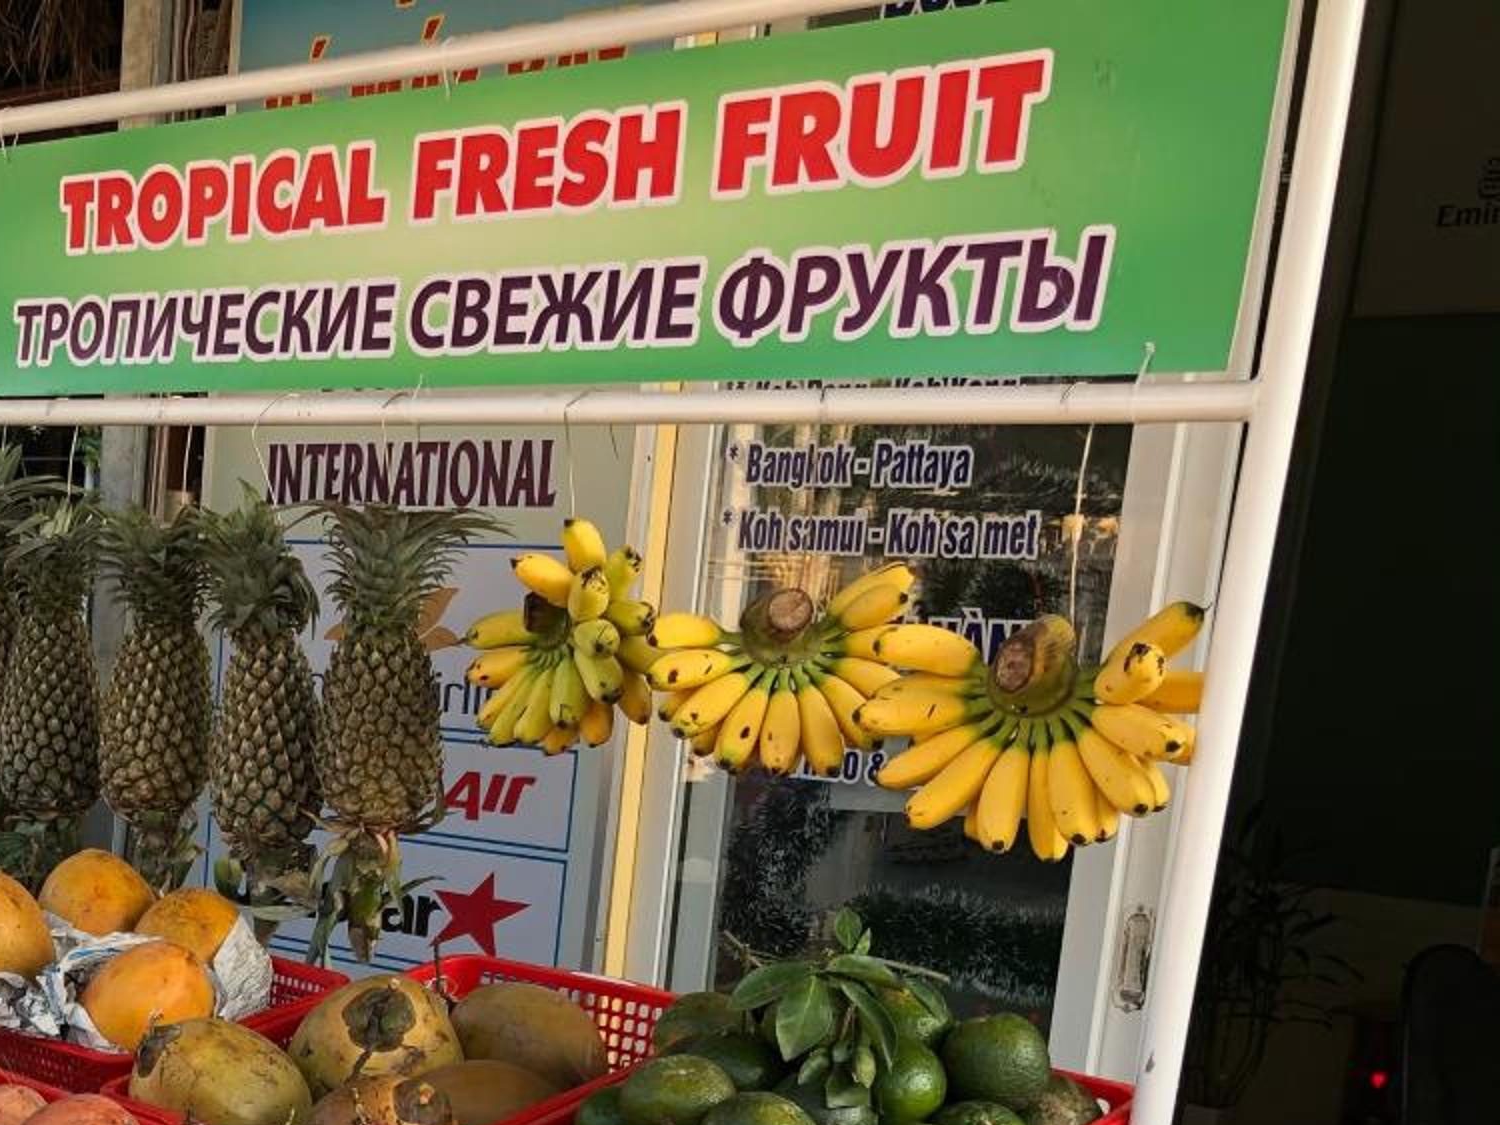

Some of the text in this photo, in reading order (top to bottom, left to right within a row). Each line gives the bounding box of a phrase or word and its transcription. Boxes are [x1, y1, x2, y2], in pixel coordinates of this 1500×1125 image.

[61, 146, 387, 251] TROPICAL
[412, 107, 682, 221] FRESH
[715, 57, 1047, 192] FRUIT
[17, 234, 1108, 363] ТРОПИЧЕСКИЕ СВЕЖИЕ ФРУКТЫ
[266, 439, 557, 509] INTERNATIONAL
[745, 442, 852, 489] Bangkok
[873, 442, 972, 489] Pattaya
[738, 510, 783, 551] Koh
[887, 512, 937, 555] Koh
[442, 770, 537, 821] Air
